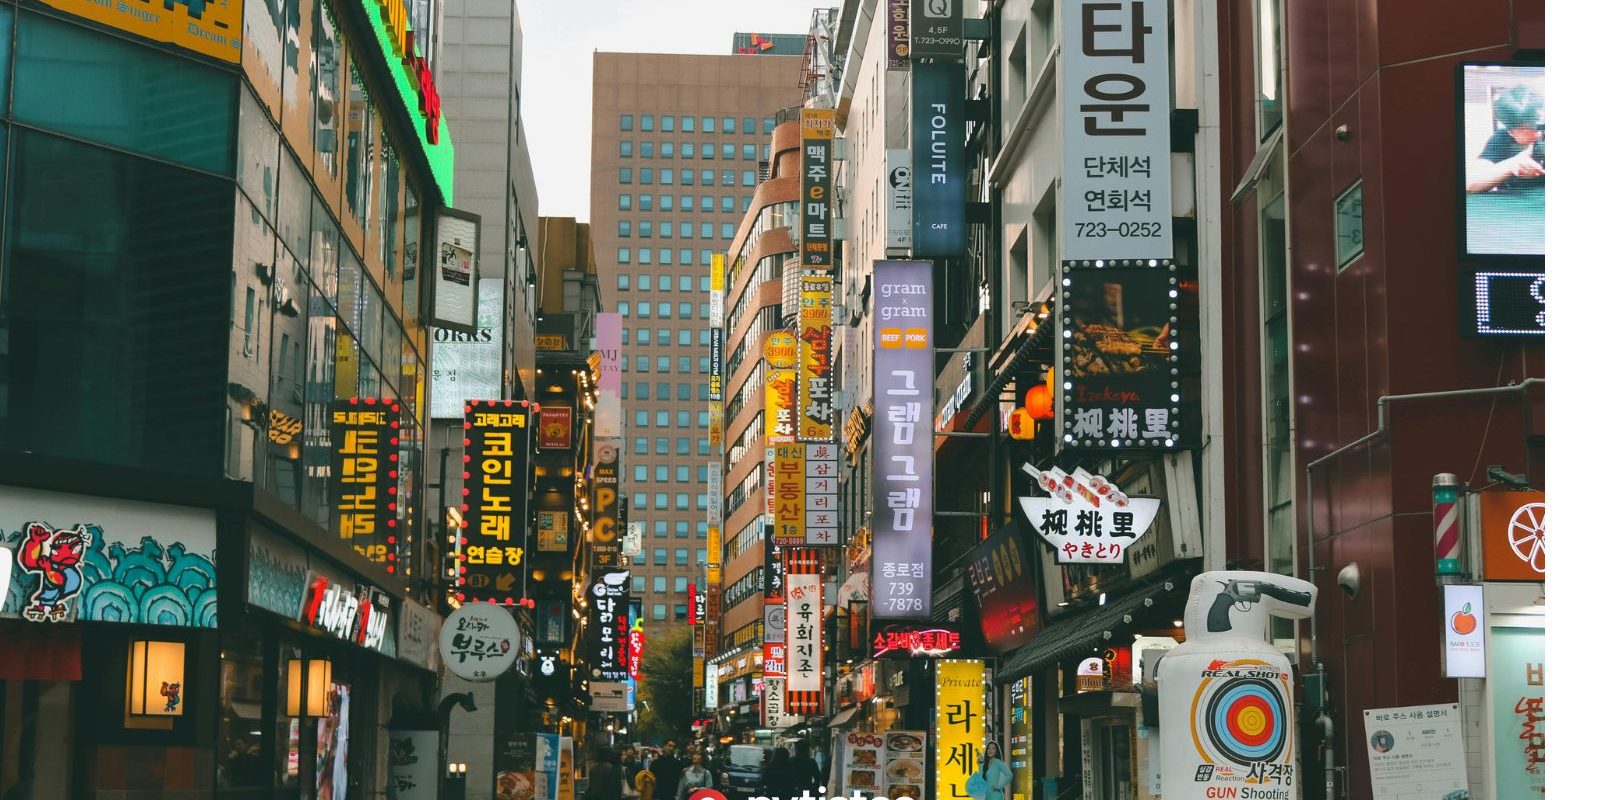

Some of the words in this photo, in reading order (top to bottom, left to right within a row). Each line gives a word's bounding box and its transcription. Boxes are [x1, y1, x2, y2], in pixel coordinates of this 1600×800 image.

[1080, 2, 1152, 136] 타운
[931, 103, 946, 184] FOLUITE
[1084, 156, 1151, 178] 단체석
[807, 145, 827, 238] 맥주e마트
[1084, 189, 1151, 212] 연회석
[1075, 222, 1162, 238] 723-0252
[881, 282, 927, 297] gram
[881, 305, 927, 320] gram
[881, 333, 900, 342] BEEF
[905, 333, 926, 342] PORK
[474, 413, 525, 427] 고래고래
[778, 447, 802, 459] 대신
[480, 432, 512, 541] 코인노래
[778, 462, 801, 521] 부동산
[467, 545, 523, 565] 연습장
[1062, 541, 1121, 559] やきとり
[599, 554, 611, 563] 3F
[882, 562, 924, 578] 종로점
[889, 583, 914, 595] 739
[883, 599, 923, 611] -7878
[456, 617, 490, 632] 오사카
[796, 602, 814, 678] 육회지존
[941, 676, 983, 688] Private
[1246, 762, 1293, 786] 사격장
[1206, 787, 1237, 799] GUN
[1241, 787, 1289, 800] Shooting
